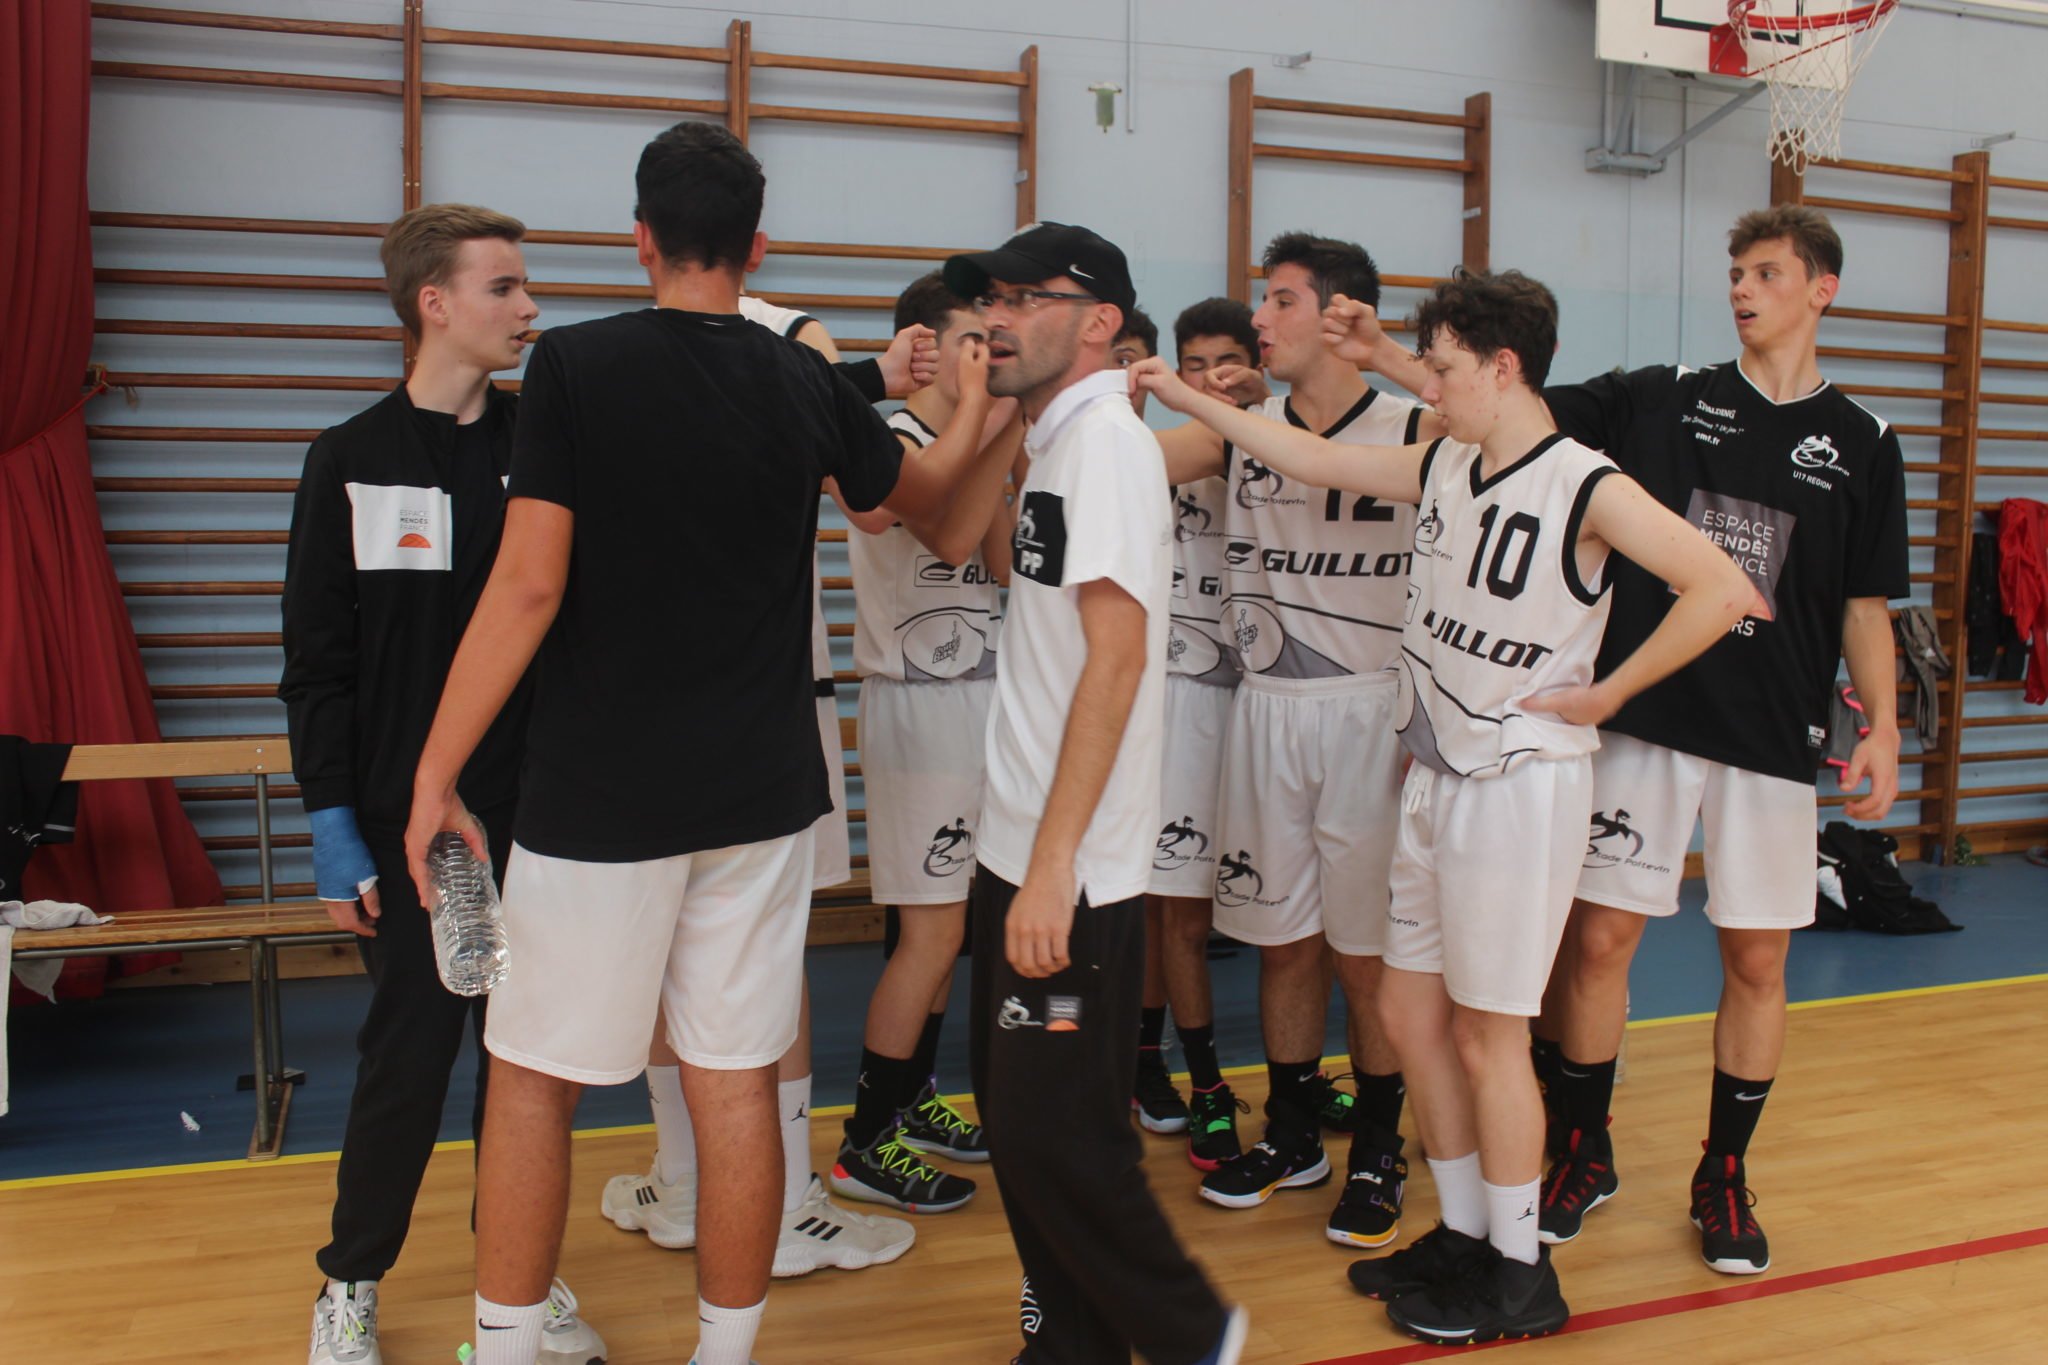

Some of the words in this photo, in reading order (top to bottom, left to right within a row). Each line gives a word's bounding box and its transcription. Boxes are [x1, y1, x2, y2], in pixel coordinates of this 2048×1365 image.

[1696, 399, 1736, 420] SPALDING
[1793, 470, 1806, 481] U17
[1806, 475, 1832, 492] REGION
[1702, 509, 1775, 543] ESPACE
[1466, 503, 1541, 601] 10
